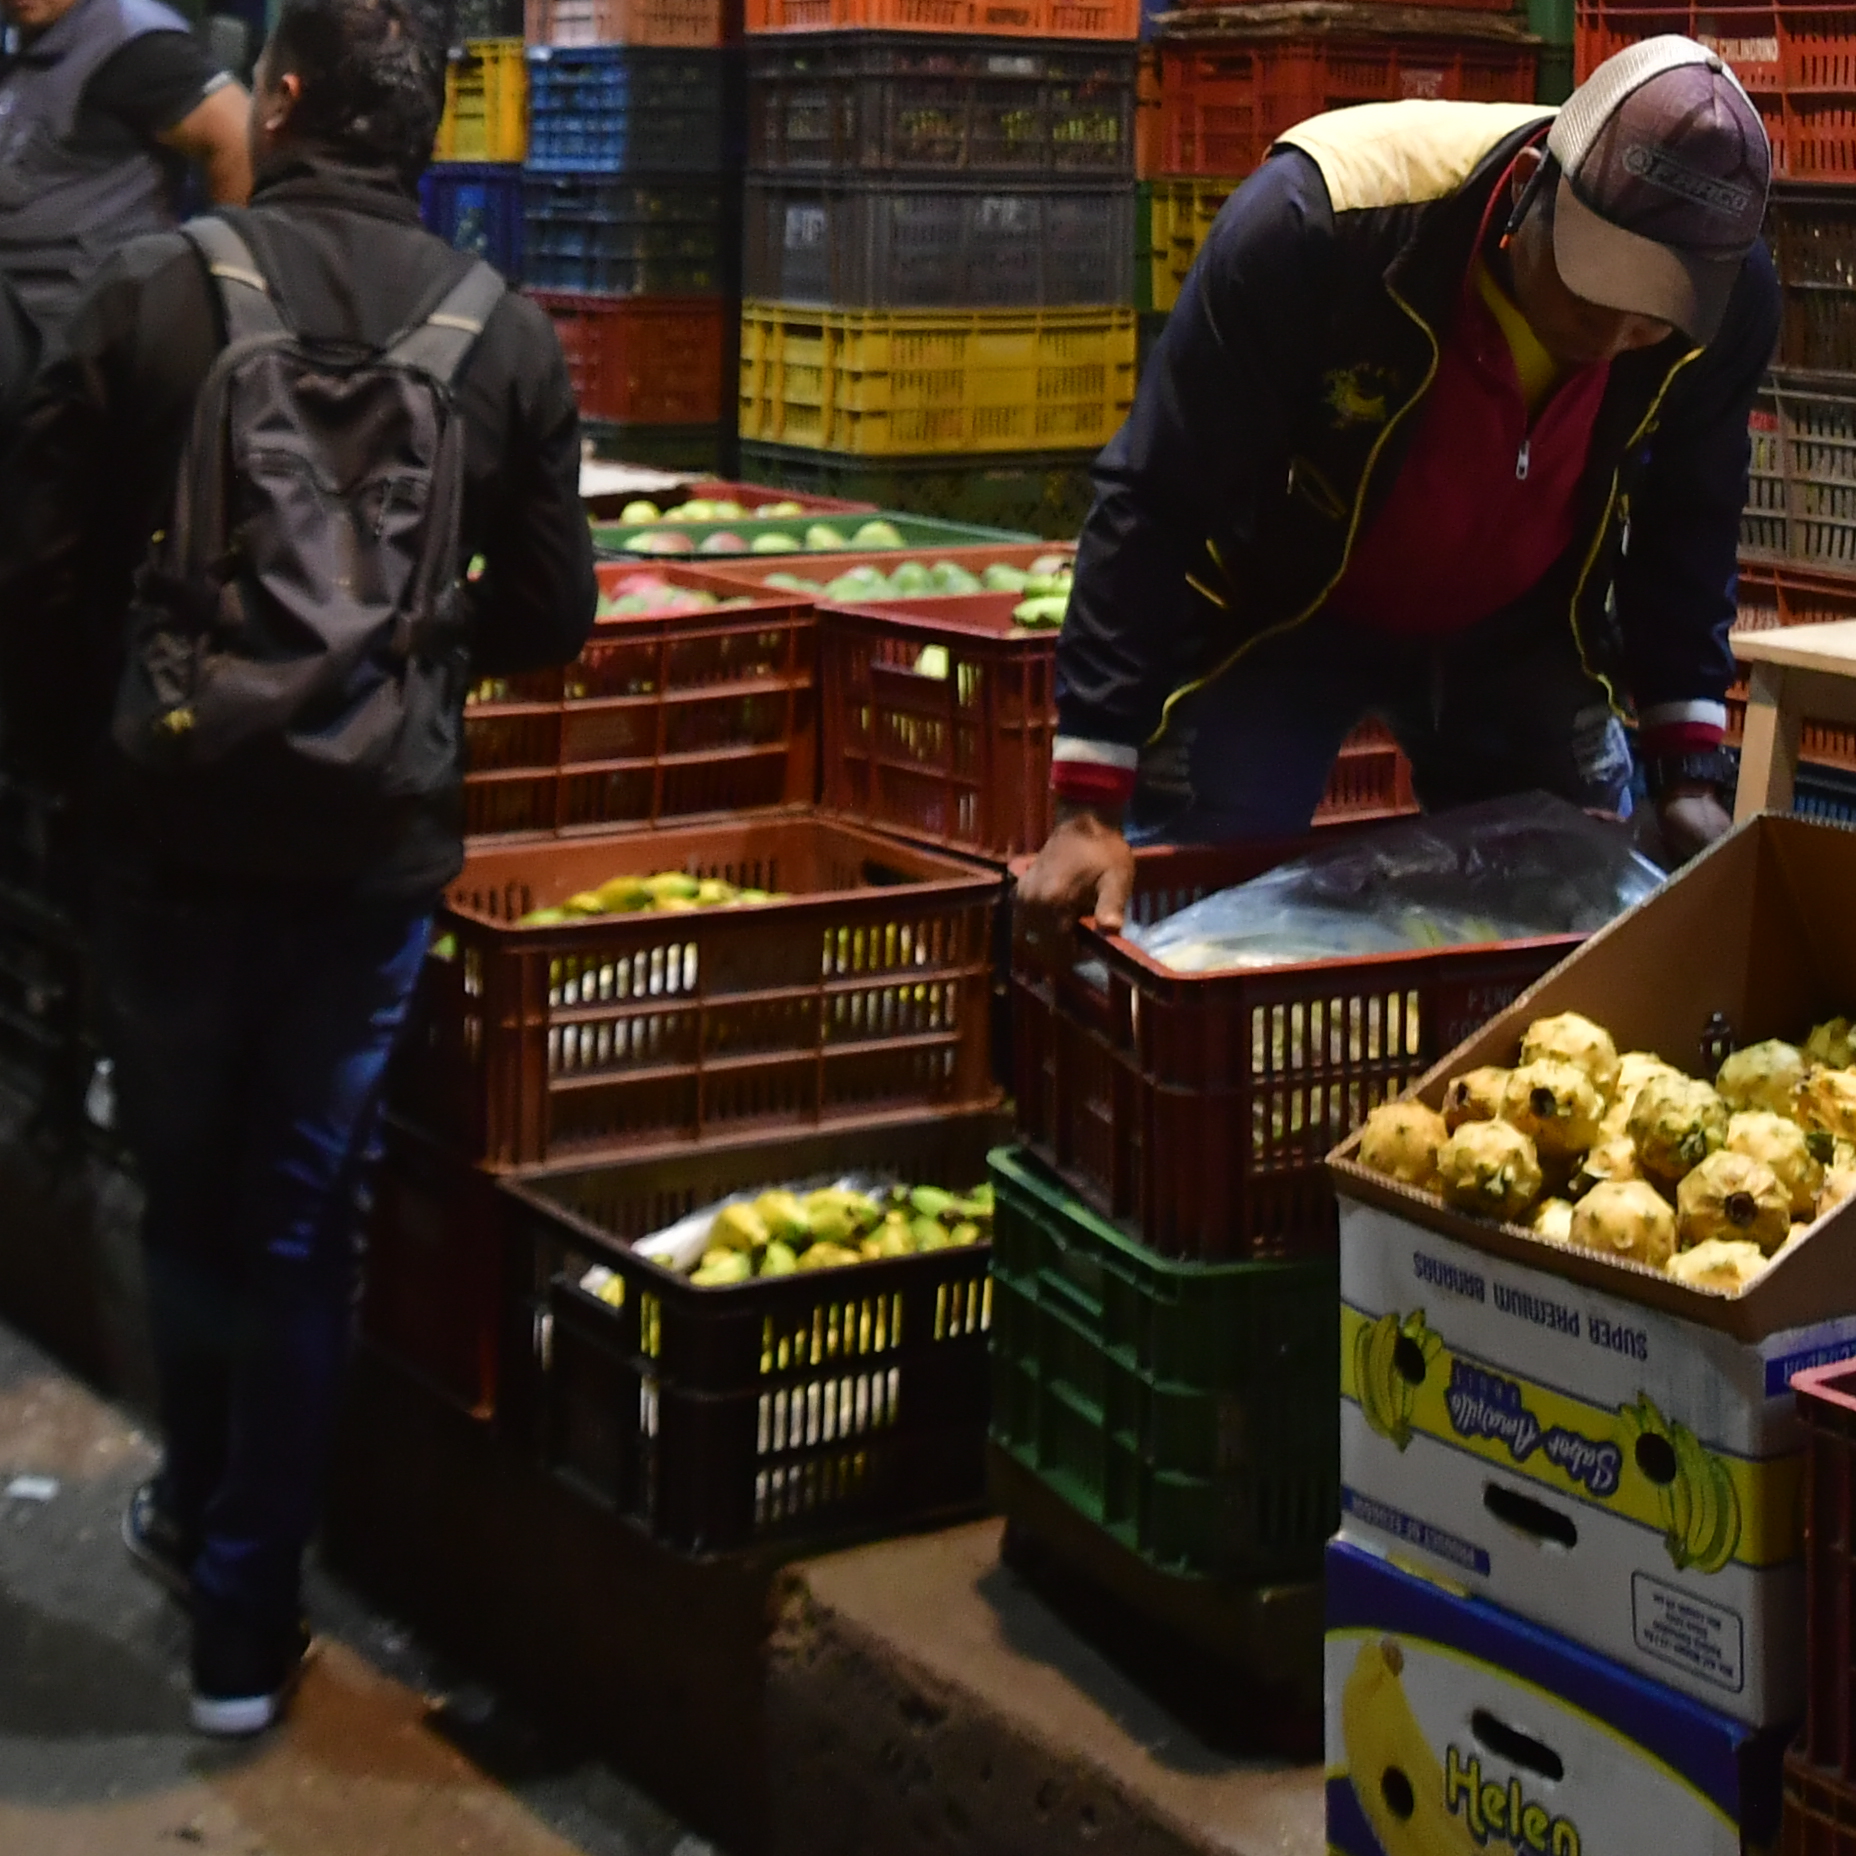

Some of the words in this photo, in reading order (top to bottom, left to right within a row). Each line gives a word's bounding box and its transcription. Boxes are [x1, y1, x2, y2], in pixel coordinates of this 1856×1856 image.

[1413, 1251, 1485, 1304] BANANAS
[1494, 1282, 1580, 1339] PREMIUM
[1589, 1315, 1648, 1361] SUPER
[1546, 1434, 1618, 1490] Sabor
